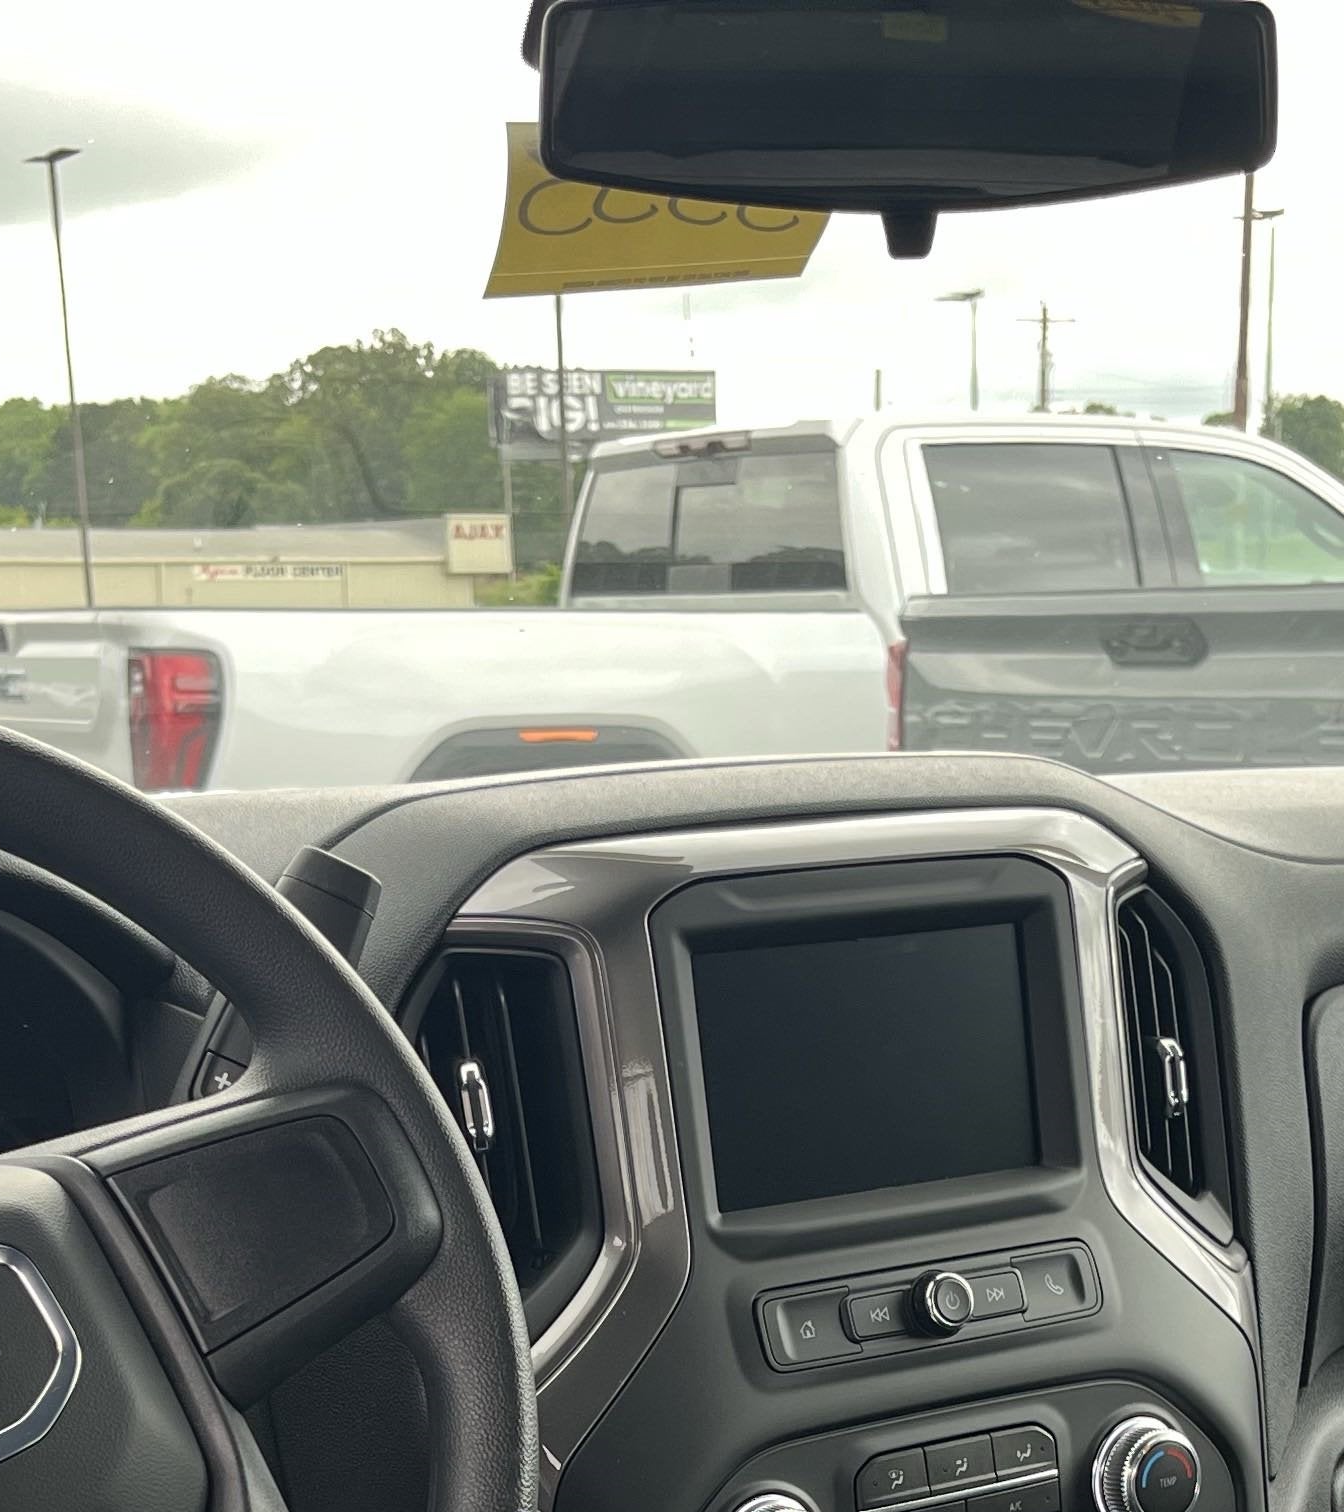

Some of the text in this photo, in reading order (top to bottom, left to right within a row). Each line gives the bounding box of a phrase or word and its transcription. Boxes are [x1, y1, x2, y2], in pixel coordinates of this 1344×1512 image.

[507, 372, 537, 395] BE
[1159, 1475, 1177, 1489] TEMP
[1008, 1501, 1022, 1512] A/C
